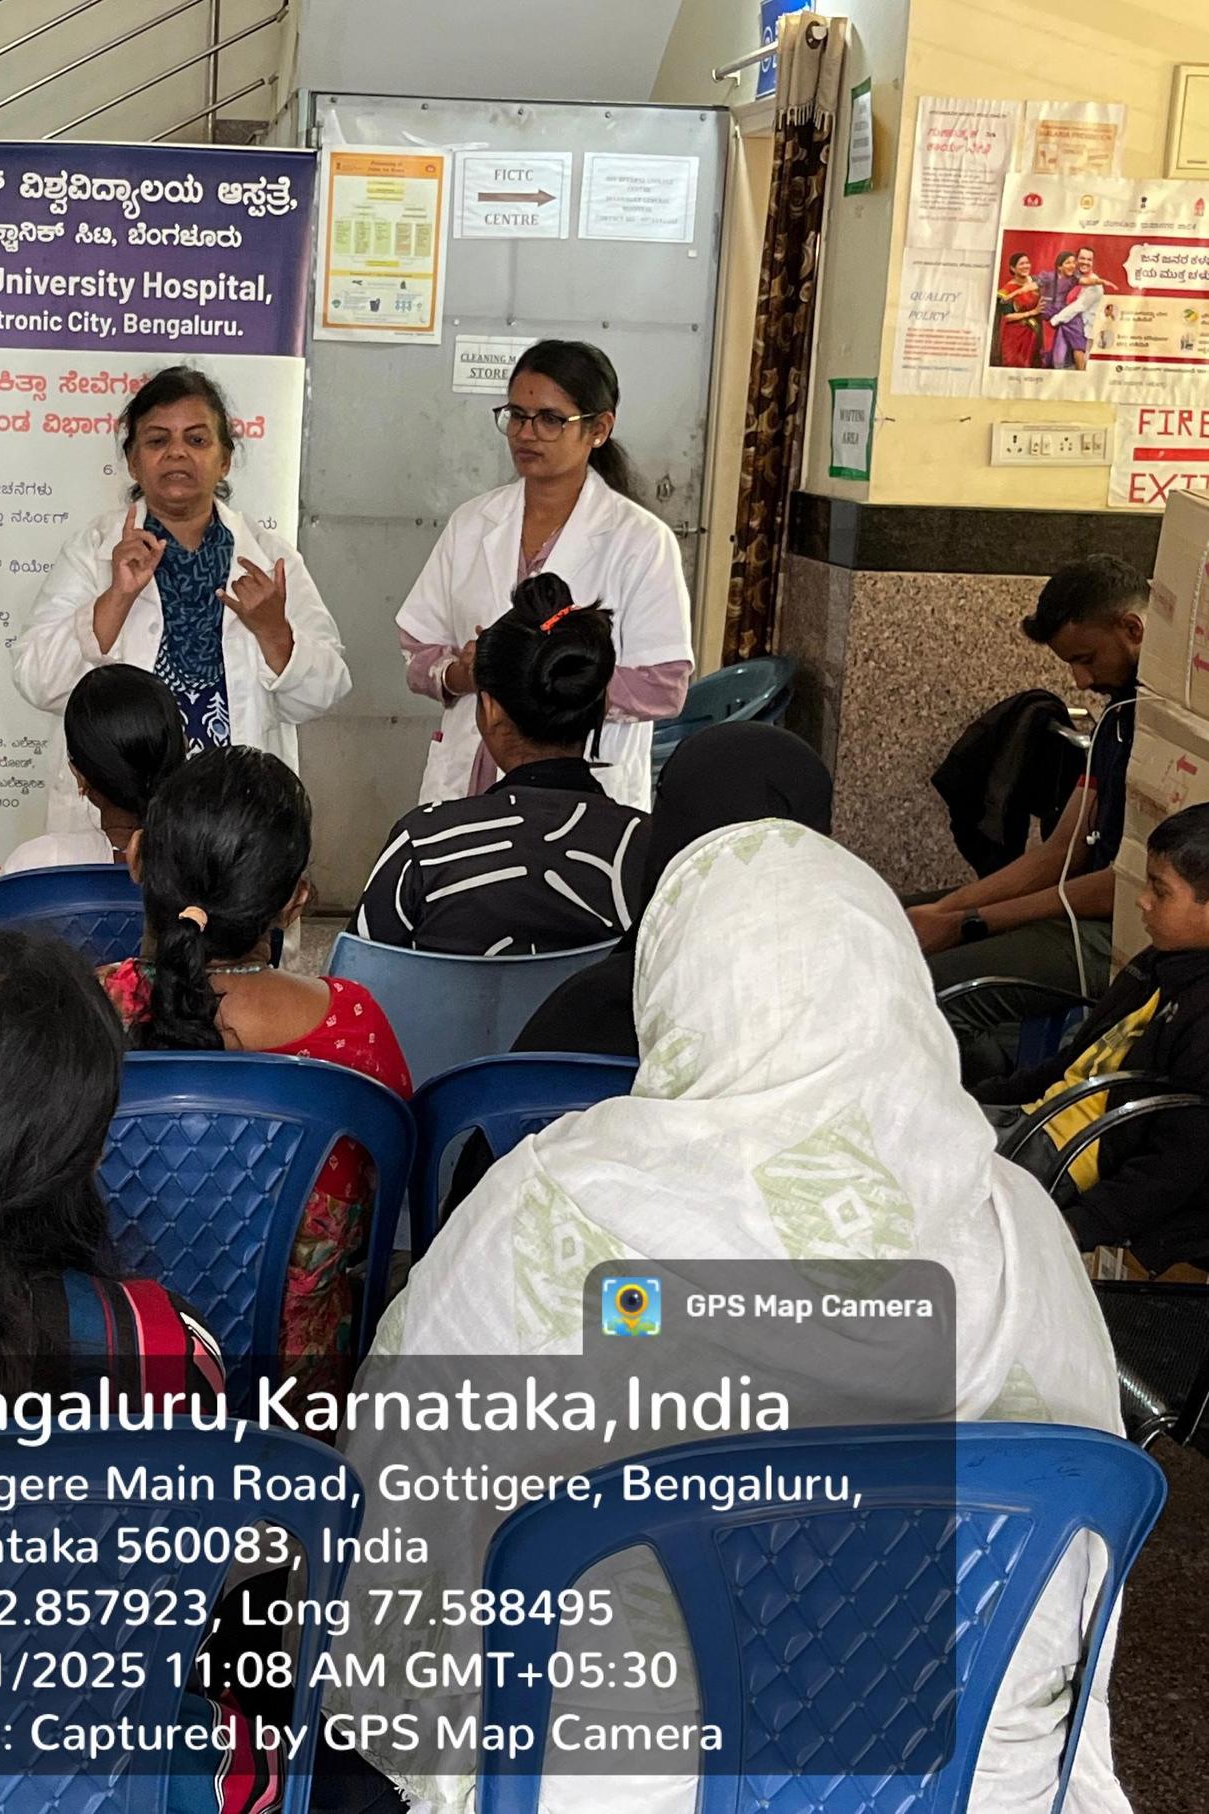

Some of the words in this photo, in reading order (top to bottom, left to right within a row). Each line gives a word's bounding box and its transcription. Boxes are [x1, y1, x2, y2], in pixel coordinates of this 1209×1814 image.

[494, 168, 534, 181] FICTC
[19, 170, 203, 219] ವಿಶ್ವವಿದ್ಯಾಲಯ
[484, 213, 540, 226] CENTRE
[128, 222, 242, 248] ಬೆಂಗಳೂರು
[143, 271, 273, 306] Hospital,
[910, 291, 961, 302] QUALITY
[909, 310, 950, 321] POLICY
[68, 311, 116, 338] City,
[124, 313, 244, 341] Bengaluru.
[460, 353, 506, 363] CLEANING
[470, 367, 509, 380] STORE
[43, 412, 120, 438] ವಿಭಾಗ
[1138, 408, 1209, 438] FIRE
